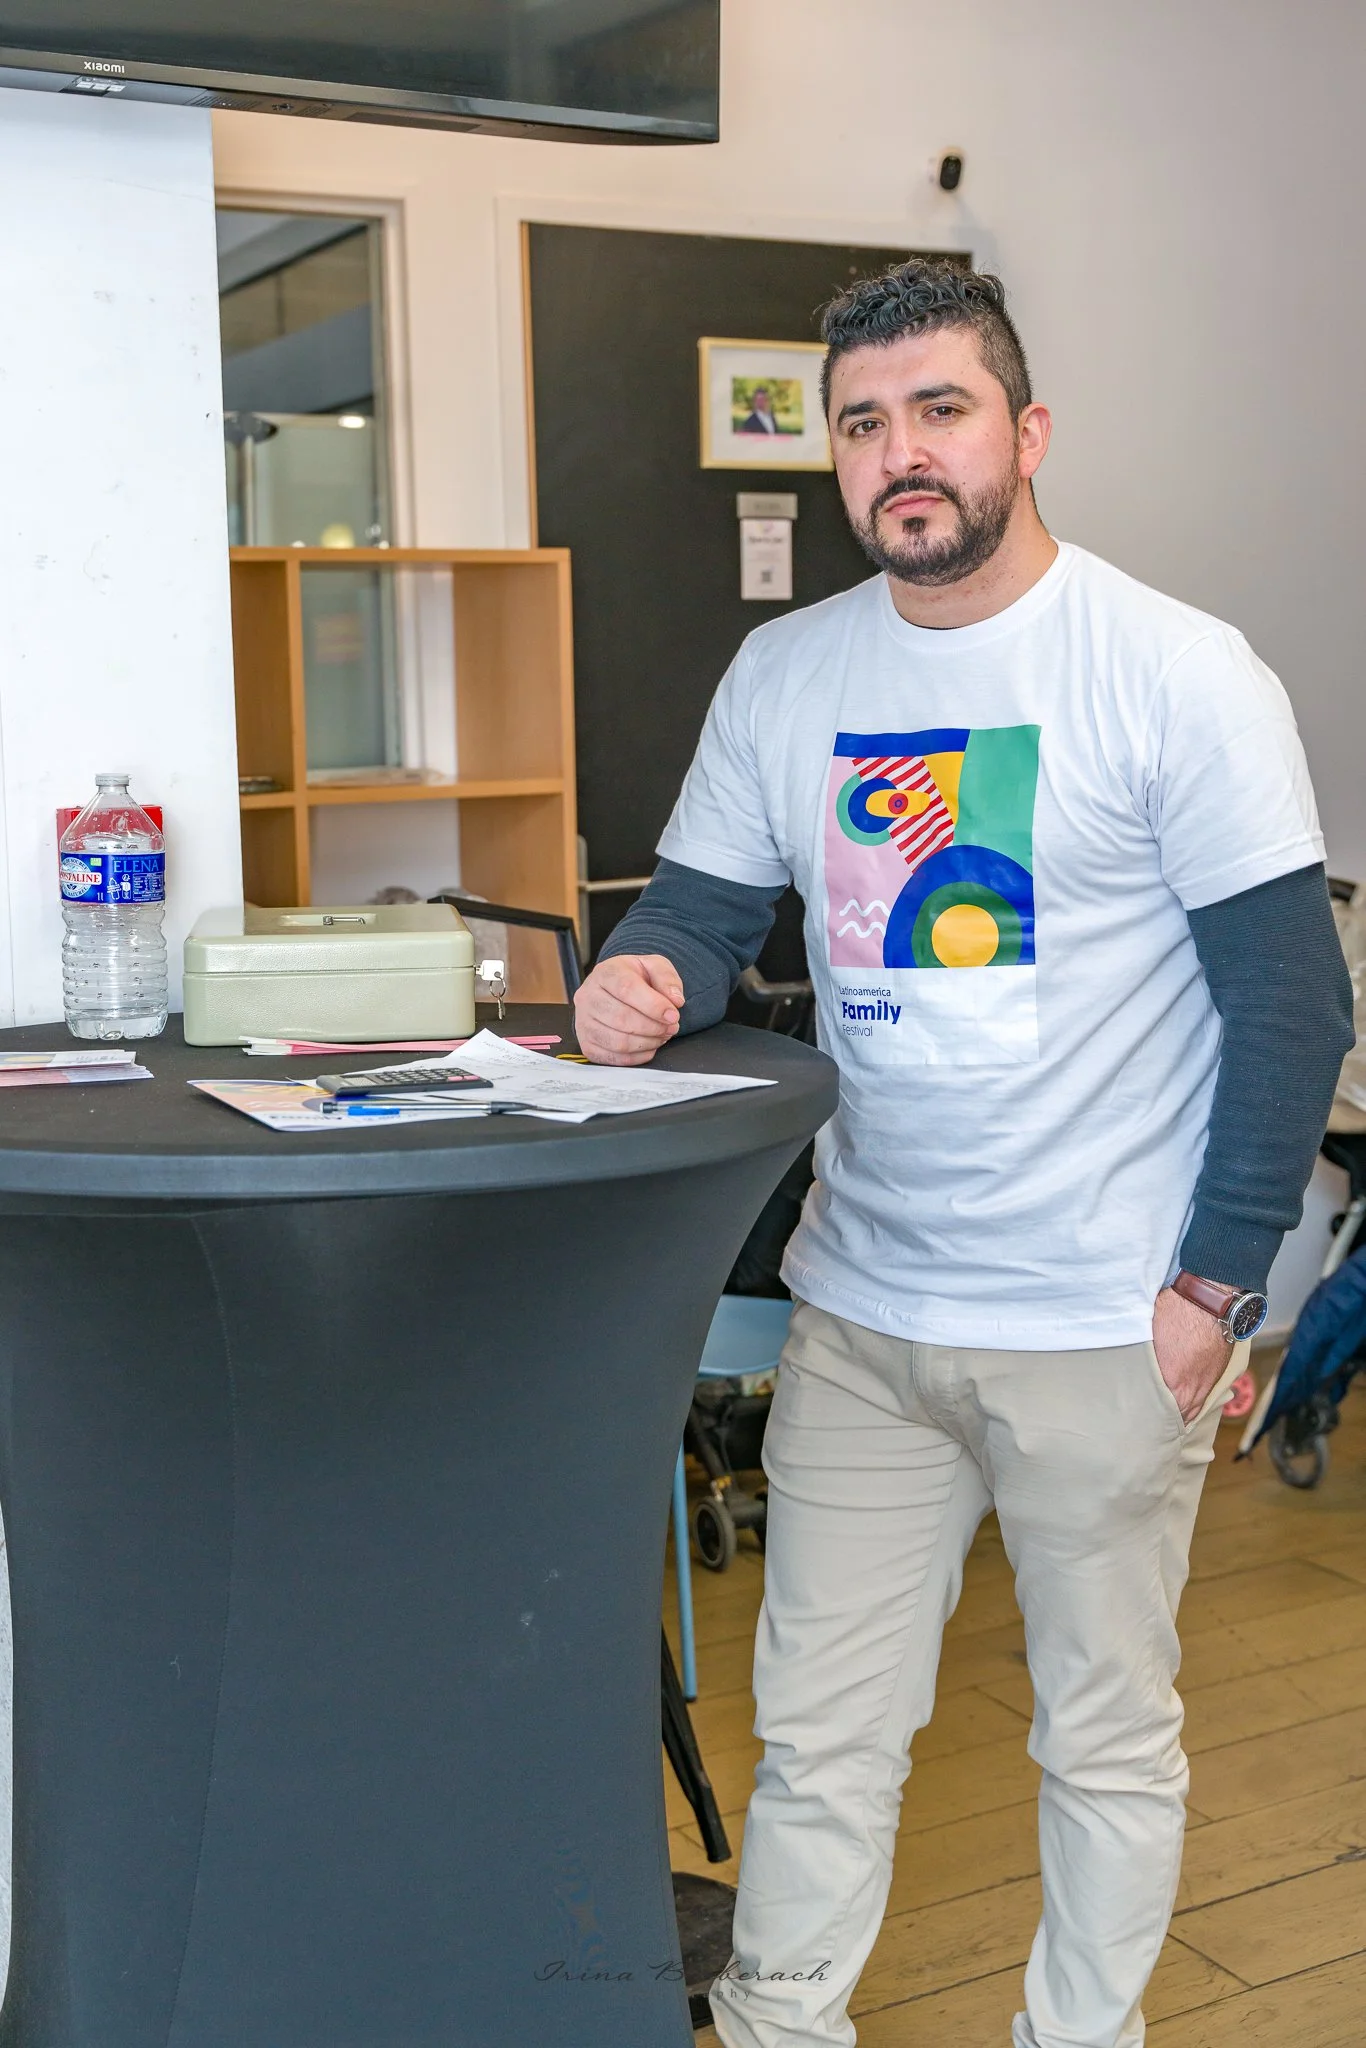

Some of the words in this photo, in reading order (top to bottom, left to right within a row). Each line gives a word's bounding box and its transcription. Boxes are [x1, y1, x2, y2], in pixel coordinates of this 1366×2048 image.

[113, 860, 159, 873] ELENA
[839, 985, 892, 997] Latinoamerica
[842, 1000, 902, 1025] Family
[842, 1024, 873, 1037] Festival
